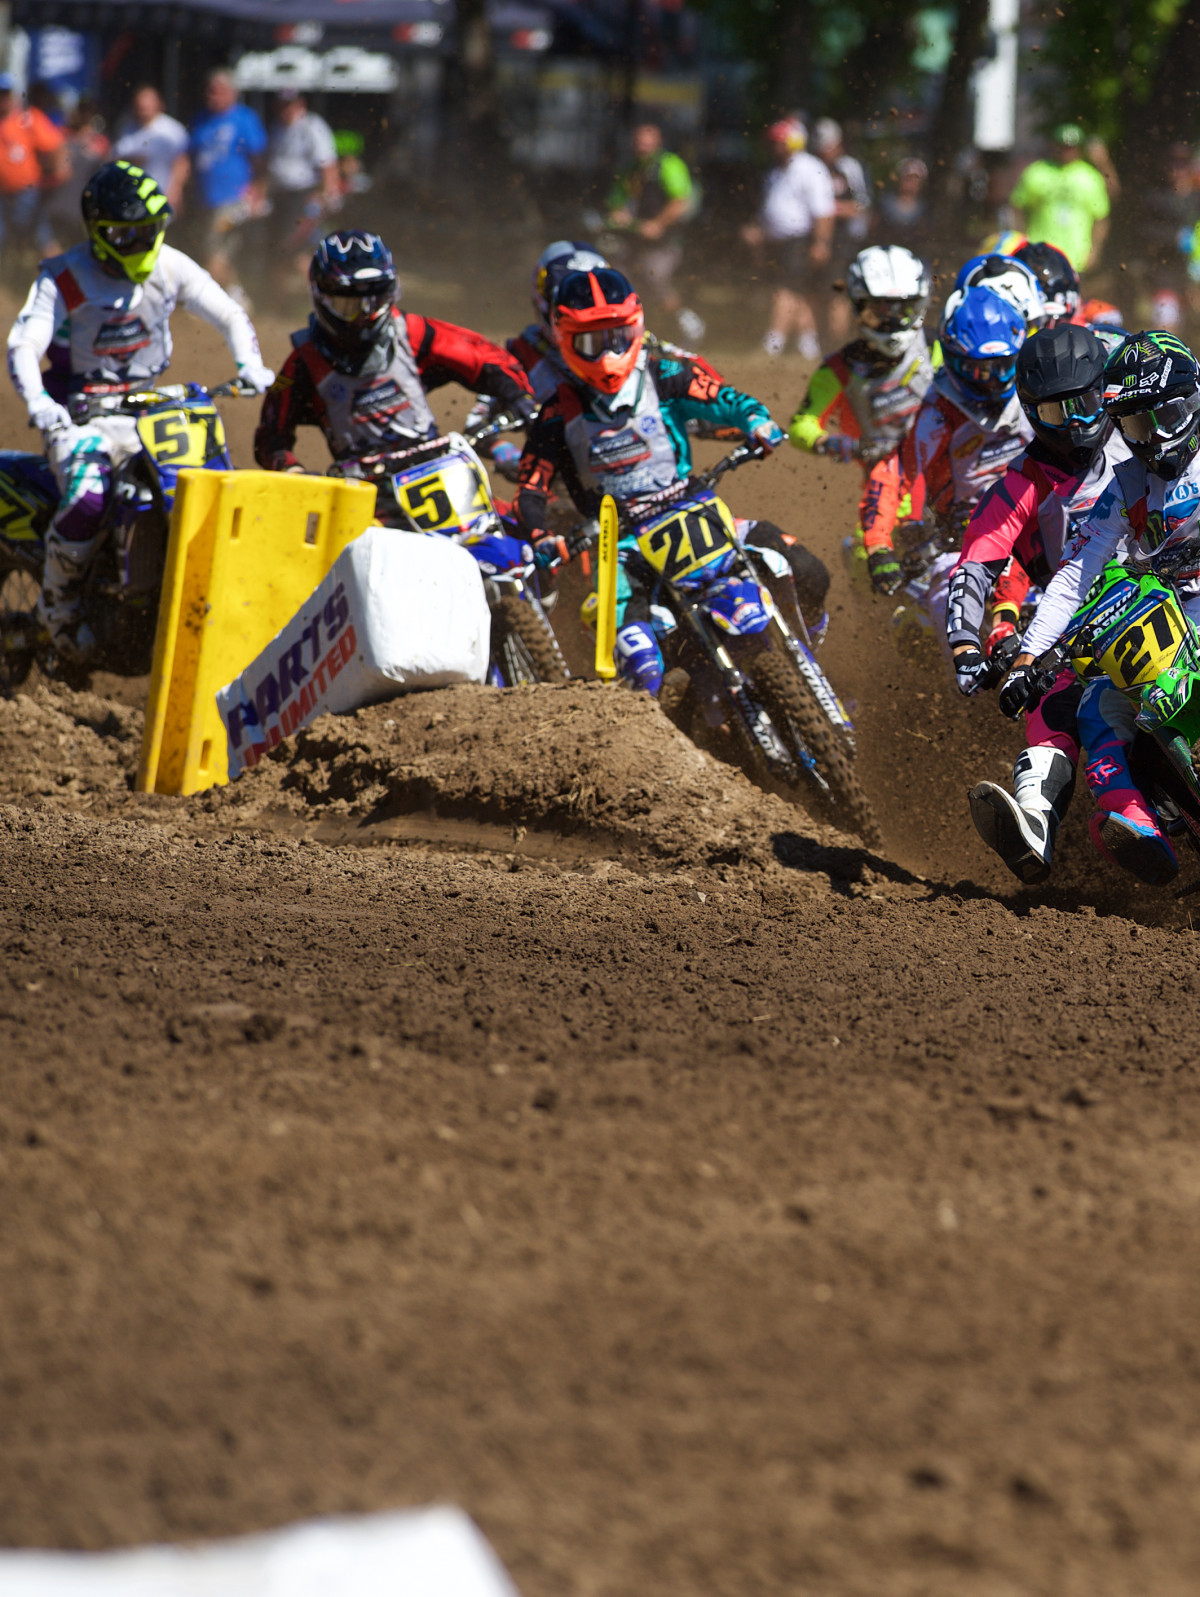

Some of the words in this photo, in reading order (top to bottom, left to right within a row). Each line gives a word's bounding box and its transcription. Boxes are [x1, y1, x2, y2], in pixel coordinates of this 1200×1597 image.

[650, 502, 733, 581] 20
[227, 581, 349, 751] PARTS
[1113, 604, 1175, 687] 21
